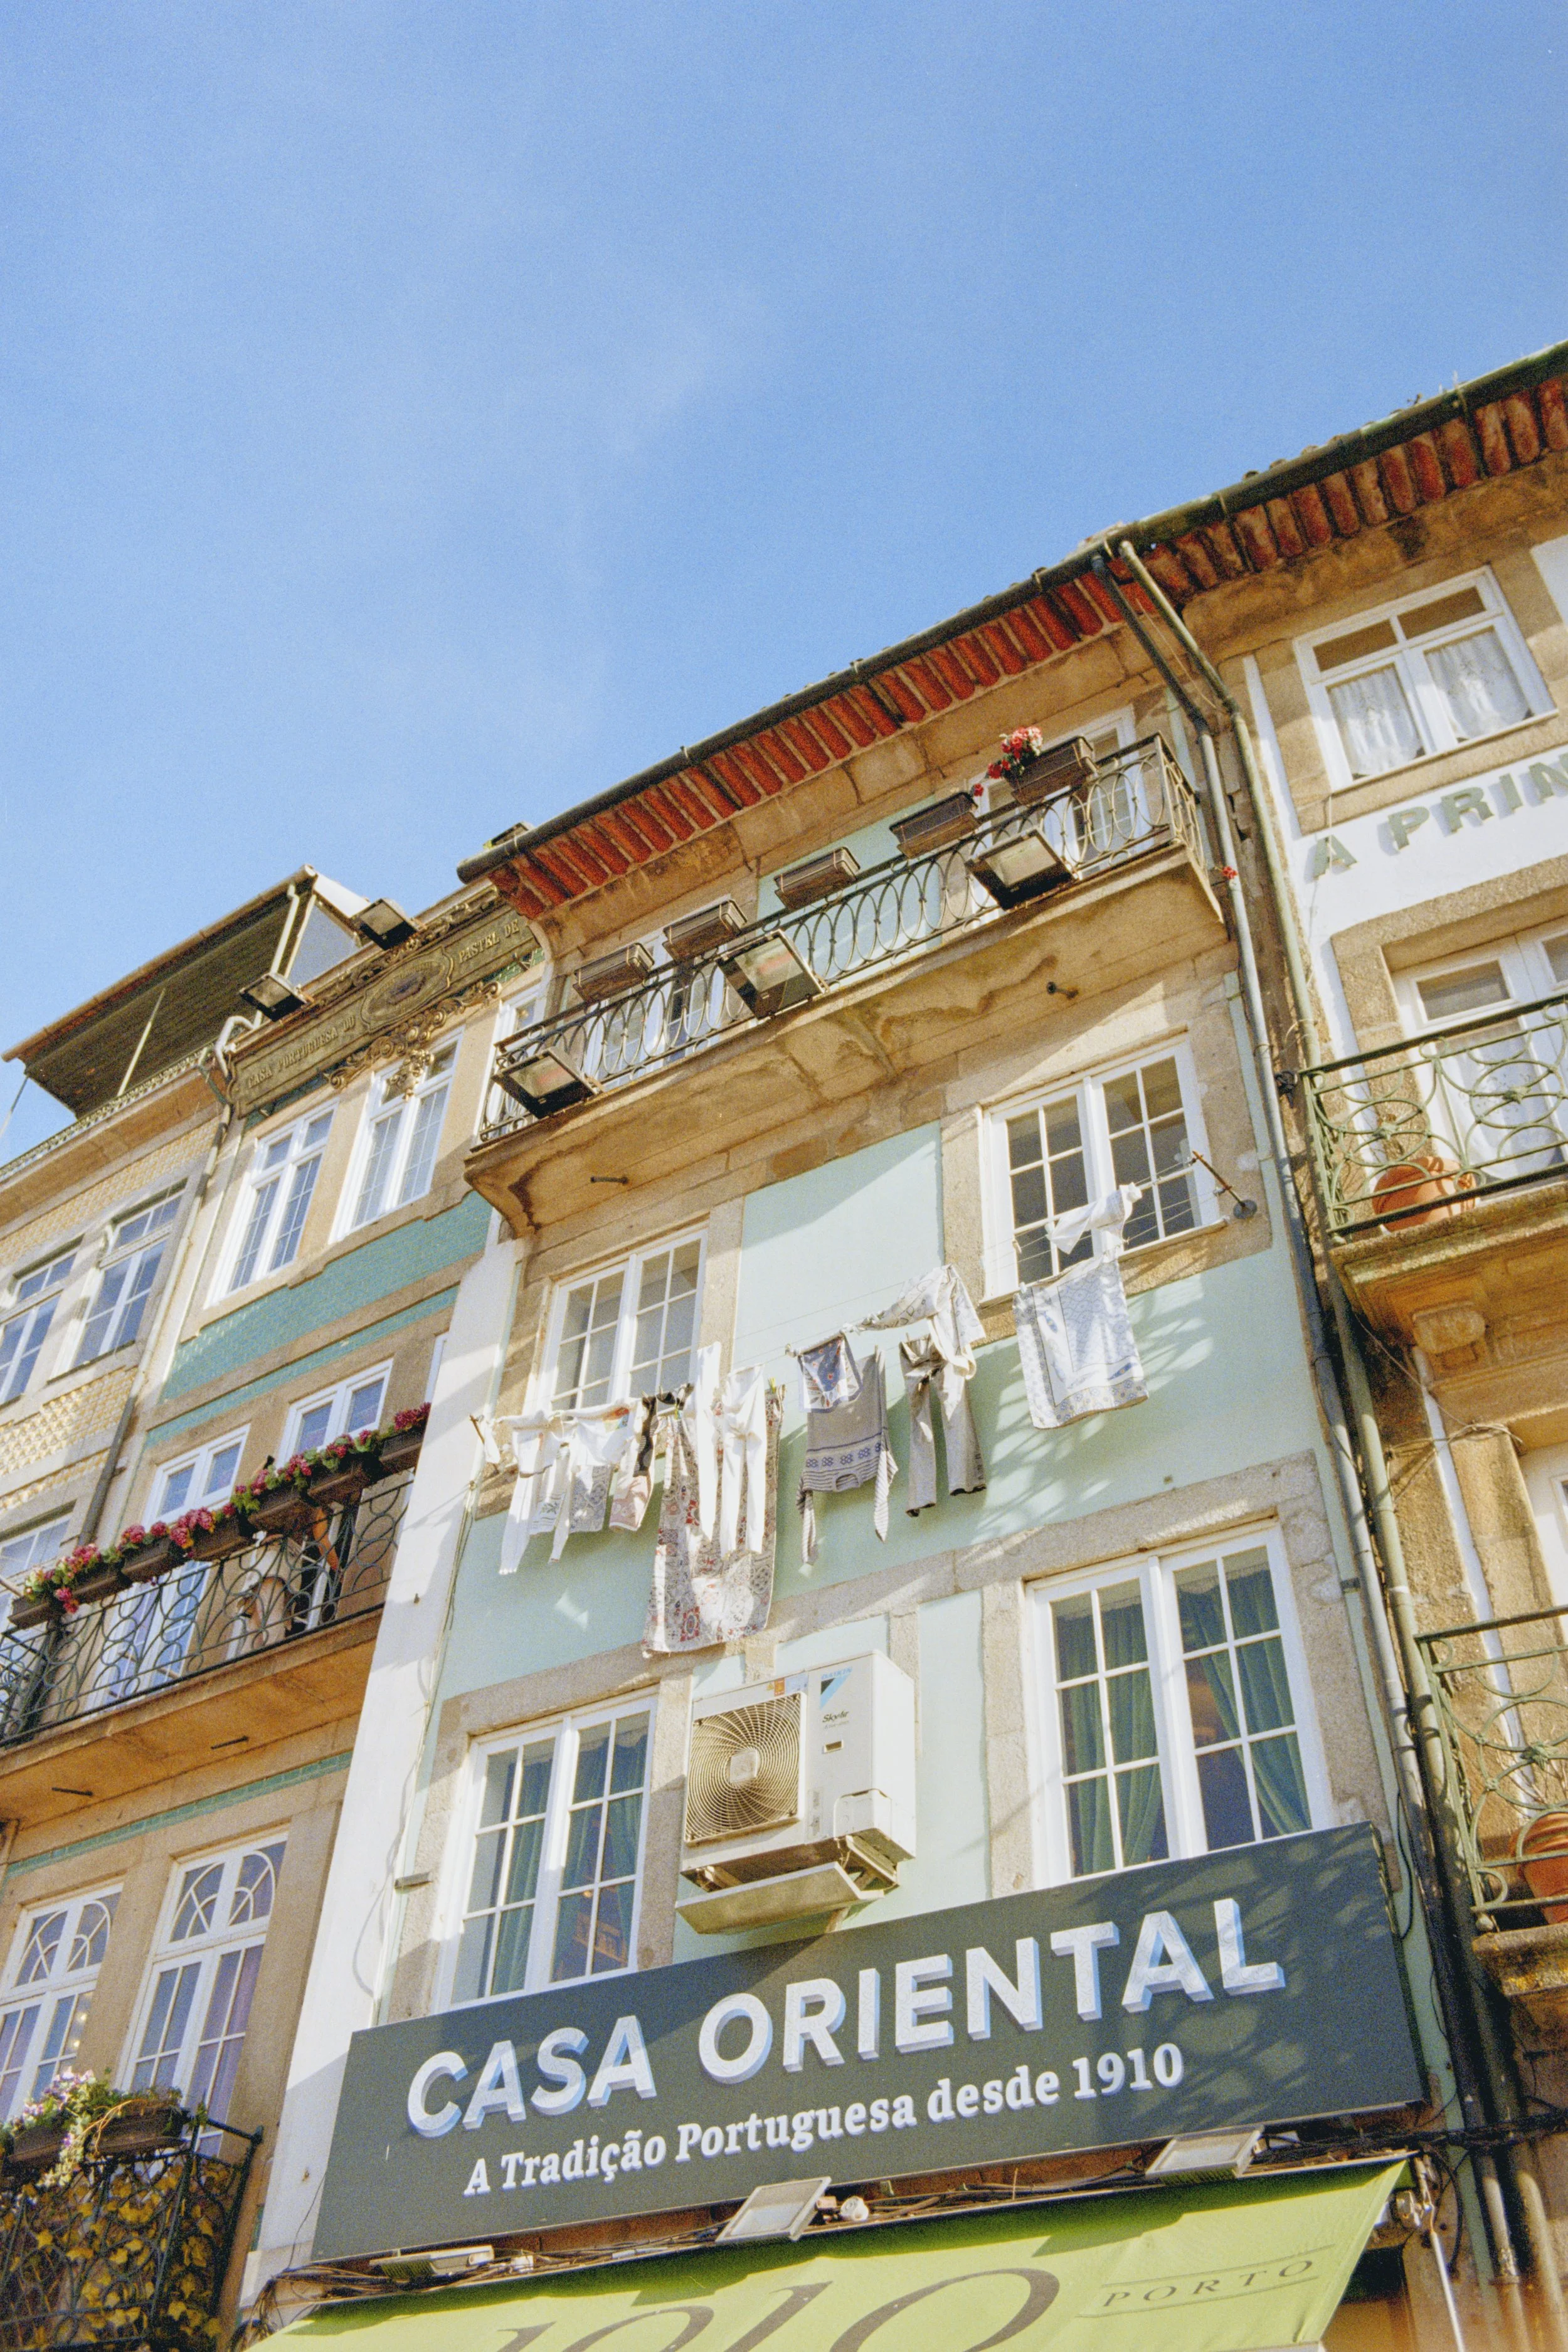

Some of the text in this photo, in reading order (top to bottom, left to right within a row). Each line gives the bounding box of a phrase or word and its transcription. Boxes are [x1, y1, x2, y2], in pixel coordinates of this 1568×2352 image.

[1313, 834, 1358, 880] A
[458, 919, 520, 963] PASTEL DE
[248, 1066, 273, 1088] CASA
[407, 1897, 1286, 2138] CASA ORIENTAL
[464, 2042, 1184, 2196] A Tradição Portuguesa desde 1910
[1103, 2259, 1313, 2307] PORTO
